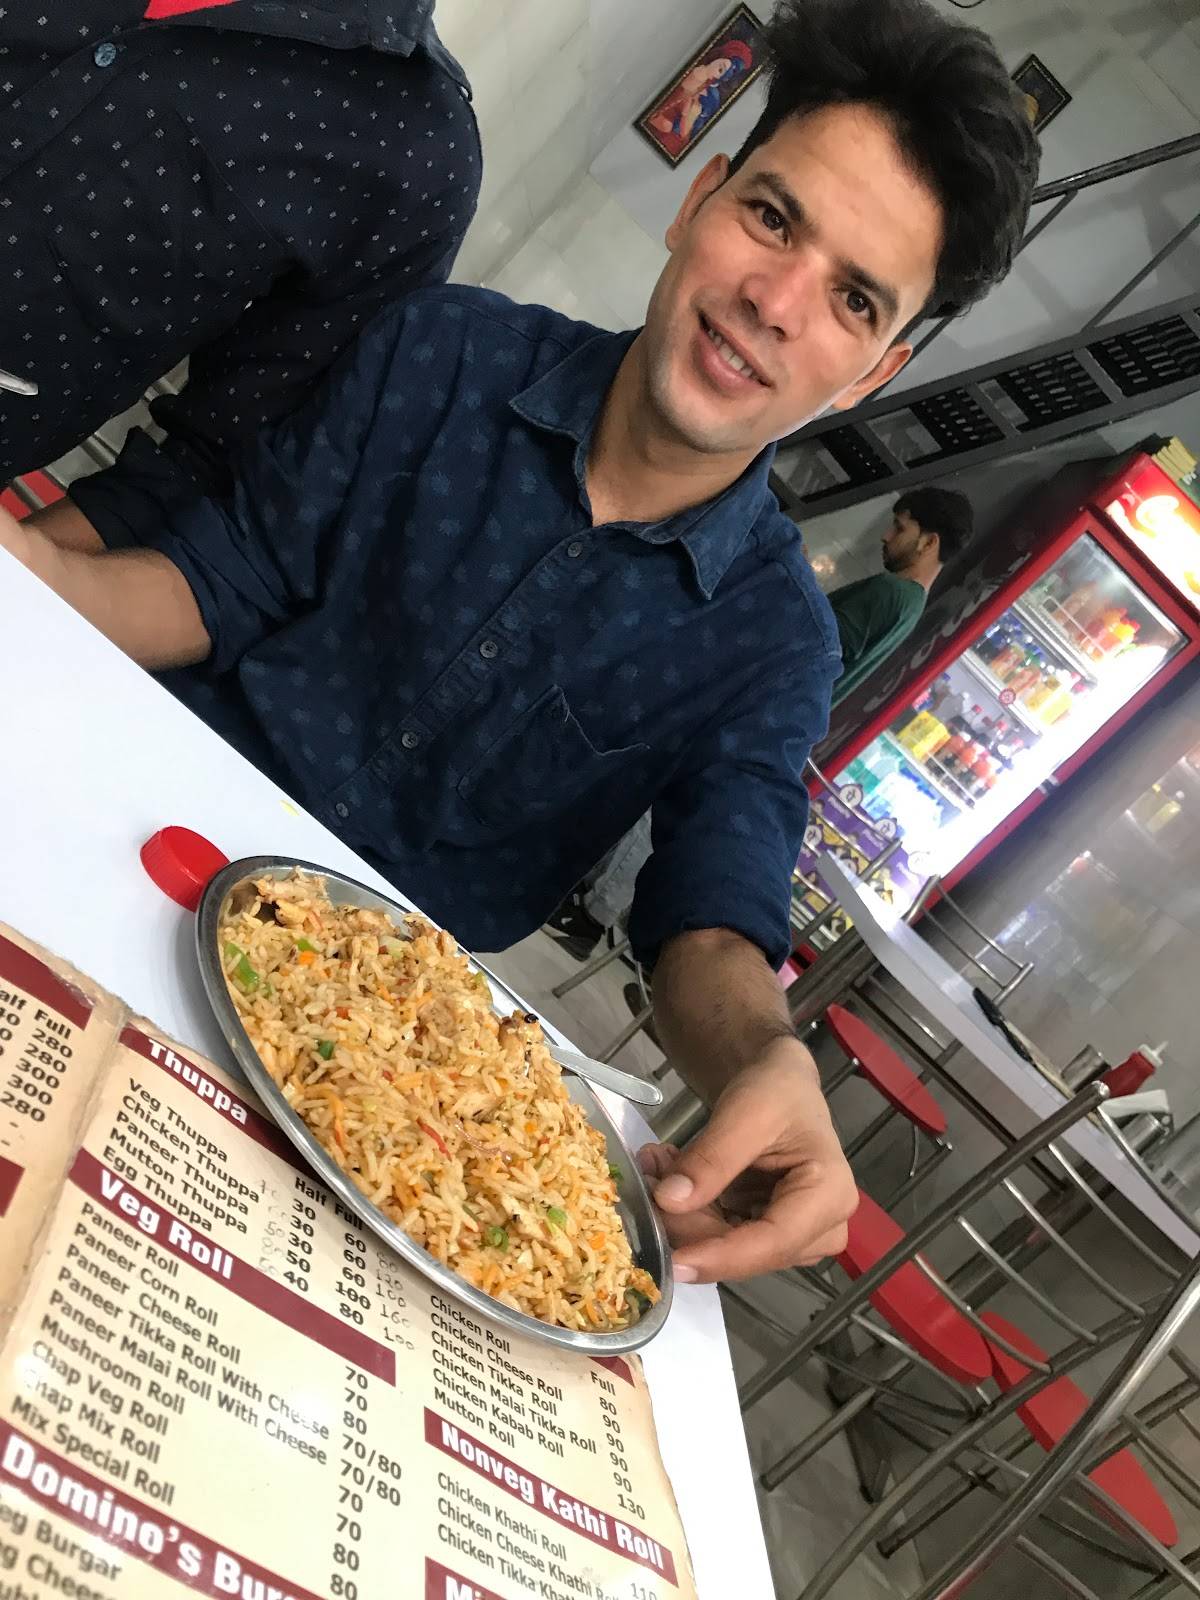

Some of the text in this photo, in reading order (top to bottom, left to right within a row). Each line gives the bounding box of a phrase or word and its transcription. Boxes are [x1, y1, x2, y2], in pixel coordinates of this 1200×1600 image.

[32, 1028, 73, 1058] 280
[34, 1009, 71, 1040] Full
[16, 1058, 60, 1089] 300
[24, 1043, 67, 1073] 280
[148, 1039, 248, 1125] Thuppa
[0, 1091, 46, 1122] 280
[7, 1074, 53, 1105] 300
[123, 1095, 260, 1203] Chicken Thuppa
[129, 1078, 228, 1163] Veg Thuppa
[103, 1145, 213, 1232] Egg Thuppa
[110, 1127, 248, 1234] Mutton Thuppa
[116, 1110, 249, 1216] Paneer Thuppa
[100, 1169, 234, 1280] Veg Roll
[292, 1198, 316, 1221] 30
[344, 1232, 367, 1253] 60
[295, 1177, 364, 1231] Half Full
[81, 1202, 180, 1278] Paneer Roll
[288, 1232, 366, 1287] 30 60
[290, 1215, 366, 1270] 30 60
[66, 1243, 241, 1365] Paneer Cheese Roll
[74, 1222, 219, 1327] Paneer Corn Roll
[283, 1270, 364, 1326] 40 80
[286, 1250, 372, 1310] 50 100
[58, 1266, 124, 1319] Paneer
[128, 1311, 177, 1354] Tikka
[180, 1343, 217, 1377] Roll
[222, 1365, 263, 1403] With
[430, 1295, 511, 1355] Chicken Roll
[40, 1313, 186, 1416] Mushroom Roll
[50, 1289, 328, 1466] Paneer Malai Roll With Cheese
[345, 1365, 369, 1390] 70
[431, 1312, 563, 1402] Chicken Cheese Roll
[431, 1330, 558, 1416] Chicken Tikka Roll
[590, 1370, 616, 1396] Full
[32, 1340, 170, 1437] Chap Veg Roll
[344, 1387, 368, 1412] 70
[432, 1349, 597, 1455] Chicken Malai Tikka Roll
[433, 1367, 565, 1458] Chicken Kabab Roll
[434, 1386, 515, 1449] Mutton Roll
[599, 1397, 617, 1416] 80
[11, 1395, 176, 1507] Mix Special Roll
[78, 1402, 116, 1439] Mix
[120, 1427, 162, 1464] Roll
[342, 1410, 368, 1435] 80
[602, 1414, 621, 1434] 90
[606, 1433, 625, 1453] 90
[340, 1458, 401, 1507] 70/80
[342, 1433, 402, 1480] 70/80
[609, 1452, 629, 1473] 90
[613, 1472, 632, 1494] 90
[337, 1484, 364, 1513] 70
[437, 1472, 567, 1562] Chicken Khathi Roll
[441, 1420, 664, 1571] Nonveg Kathi Roll
[617, 1494, 646, 1521] 130
[35, 1519, 123, 1581] Burgar
[332, 1542, 360, 1572] 80
[336, 1512, 362, 1542] 70
[437, 1497, 493, 1543] Chicken
[496, 1532, 545, 1573] Cheese
[548, 1561, 593, 1598] Khathi
[330, 1573, 358, 1600] 80
[437, 1523, 495, 1569] Chicken
[497, 1556, 536, 1592] Tikka
